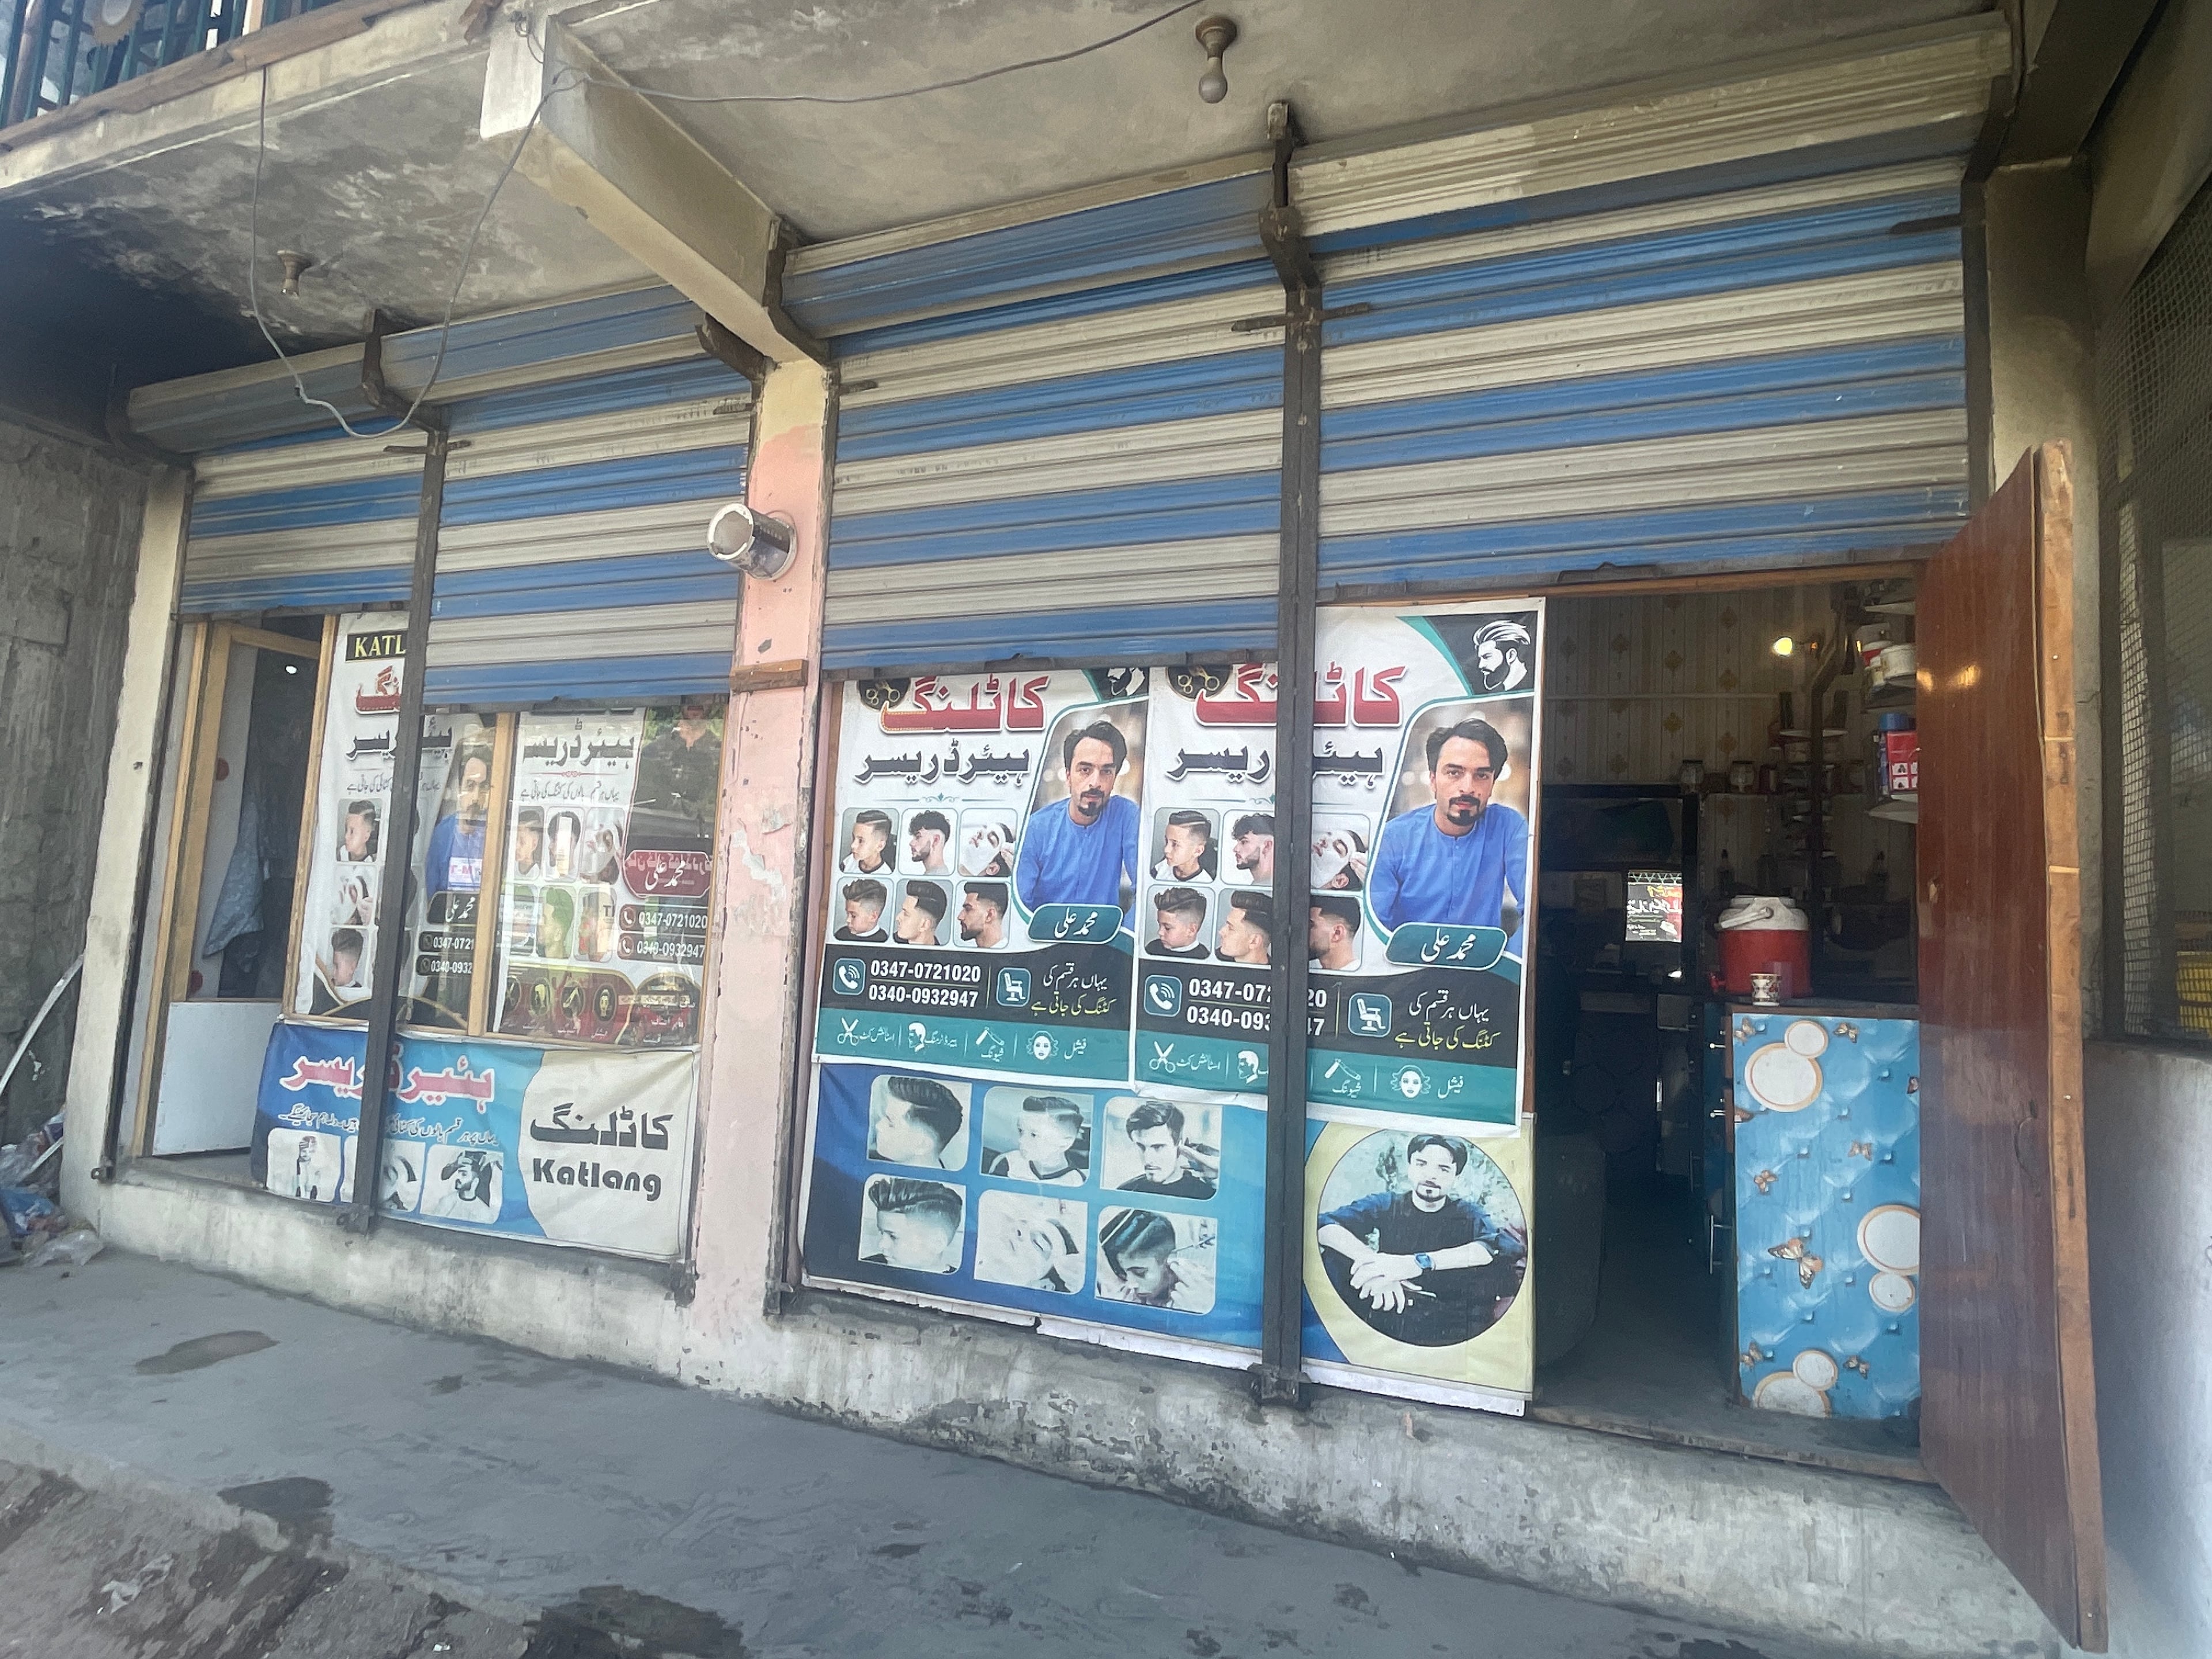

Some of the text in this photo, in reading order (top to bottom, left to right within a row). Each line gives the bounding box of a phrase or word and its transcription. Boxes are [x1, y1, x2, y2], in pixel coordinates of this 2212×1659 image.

[639, 912, 708, 929] 0347-0721020
[1054, 905, 1099, 937] محمد علی
[1421, 927, 1476, 962] محمد علی
[870, 960, 981, 982] 0347-0721020
[1043, 962, 1107, 991] یہاں ہر قسم کی
[869, 984, 979, 1007] 0340-0932947
[1049, 991, 1069, 1017] جاتی
[1071, 993, 1088, 1016] کی
[1409, 989, 1490, 1023] یہاں ہر قسم کی
[1031, 1001, 1047, 1017] ہے
[1395, 1032, 1415, 1049] ہے
[1418, 1022, 1444, 1050] جاتی
[1446, 1025, 1465, 1050] کی
[1438, 1075, 1464, 1099] فیشل
[532, 1157, 662, 1202] Katlang
